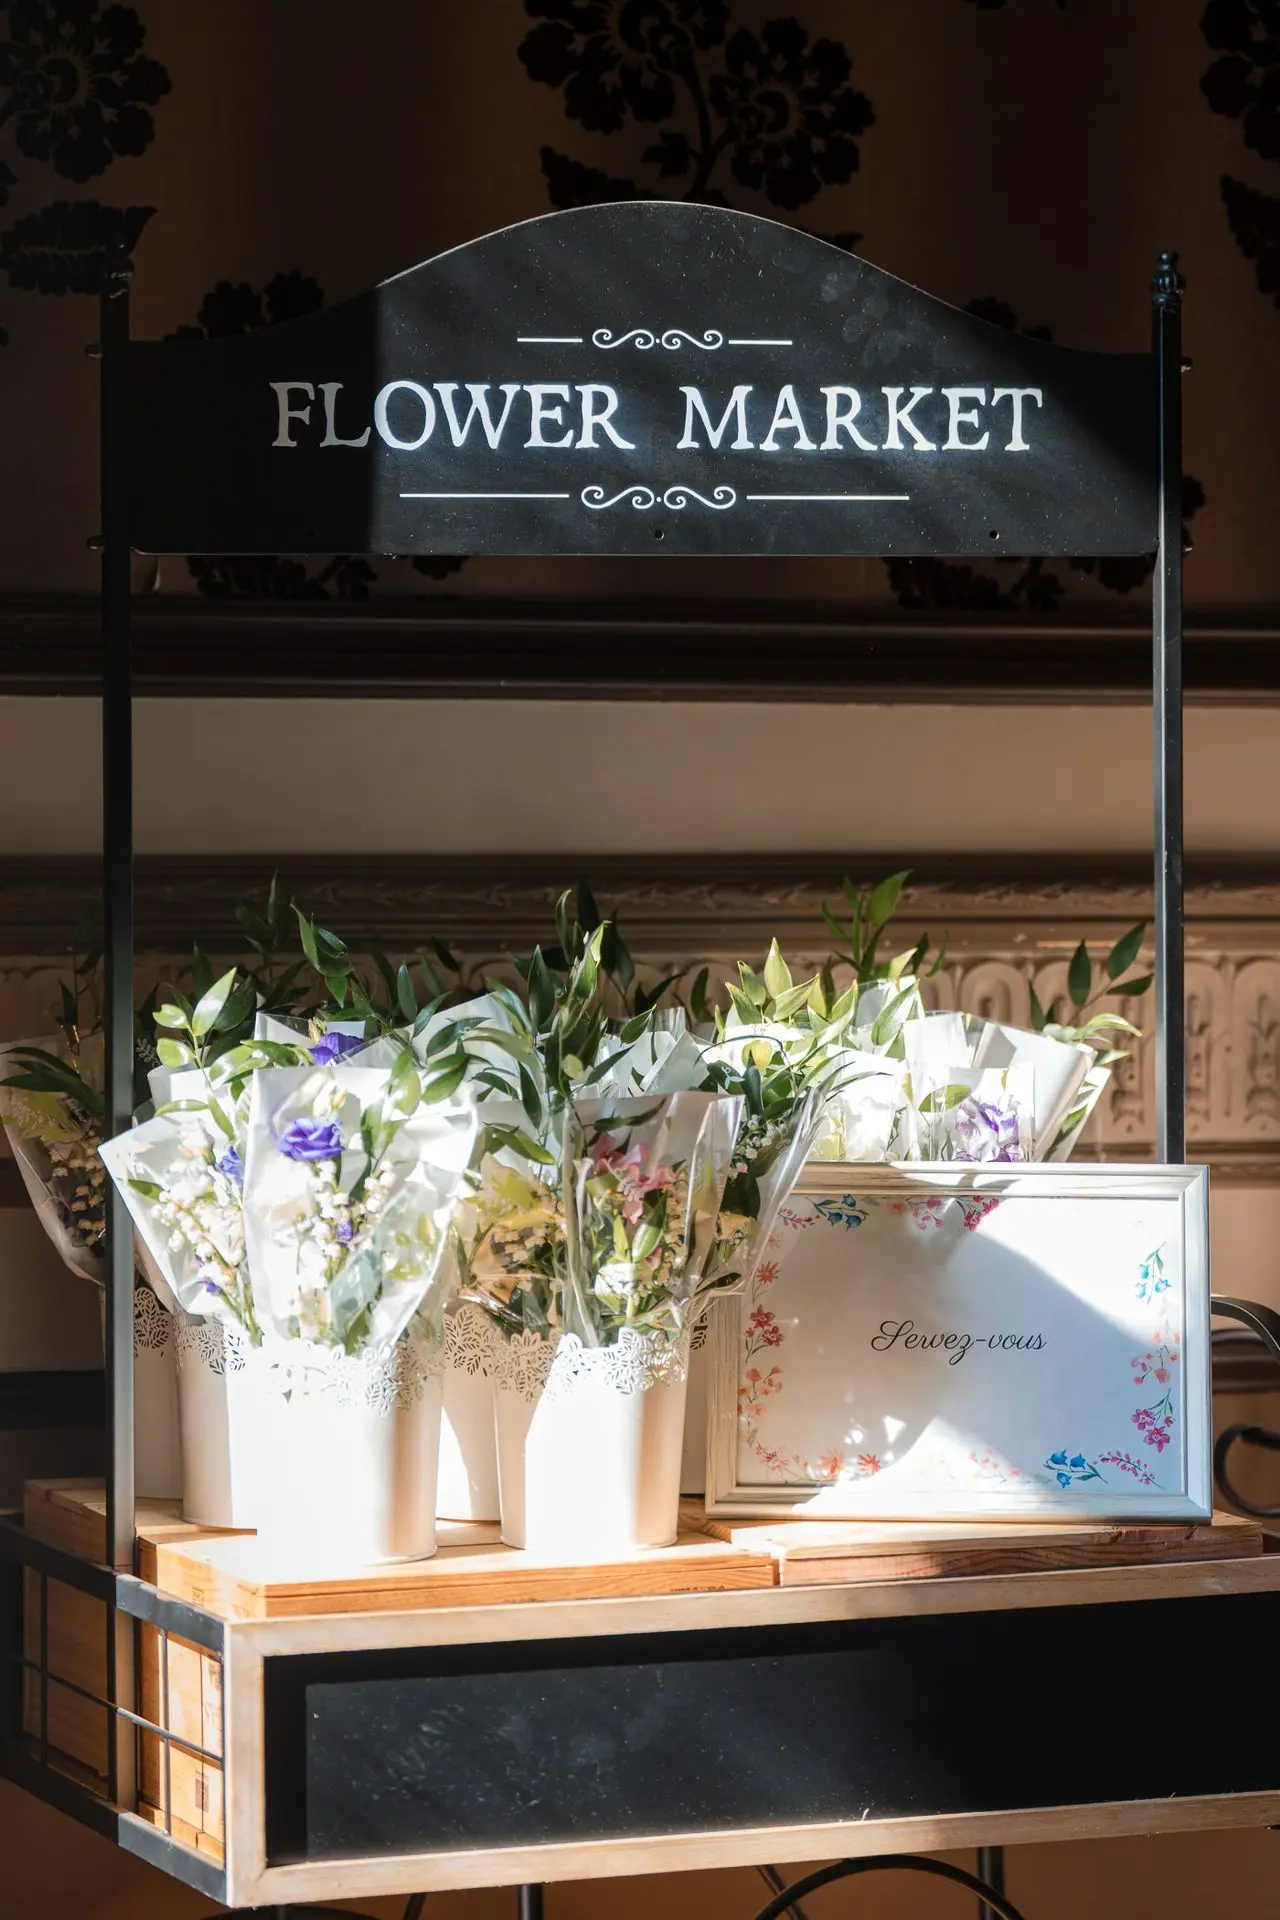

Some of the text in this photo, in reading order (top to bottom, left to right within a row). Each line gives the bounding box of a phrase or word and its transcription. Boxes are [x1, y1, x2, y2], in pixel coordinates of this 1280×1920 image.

[269, 381, 1044, 452] FLOWER MARKET
[870, 1319, 1047, 1366] Servez-vous
